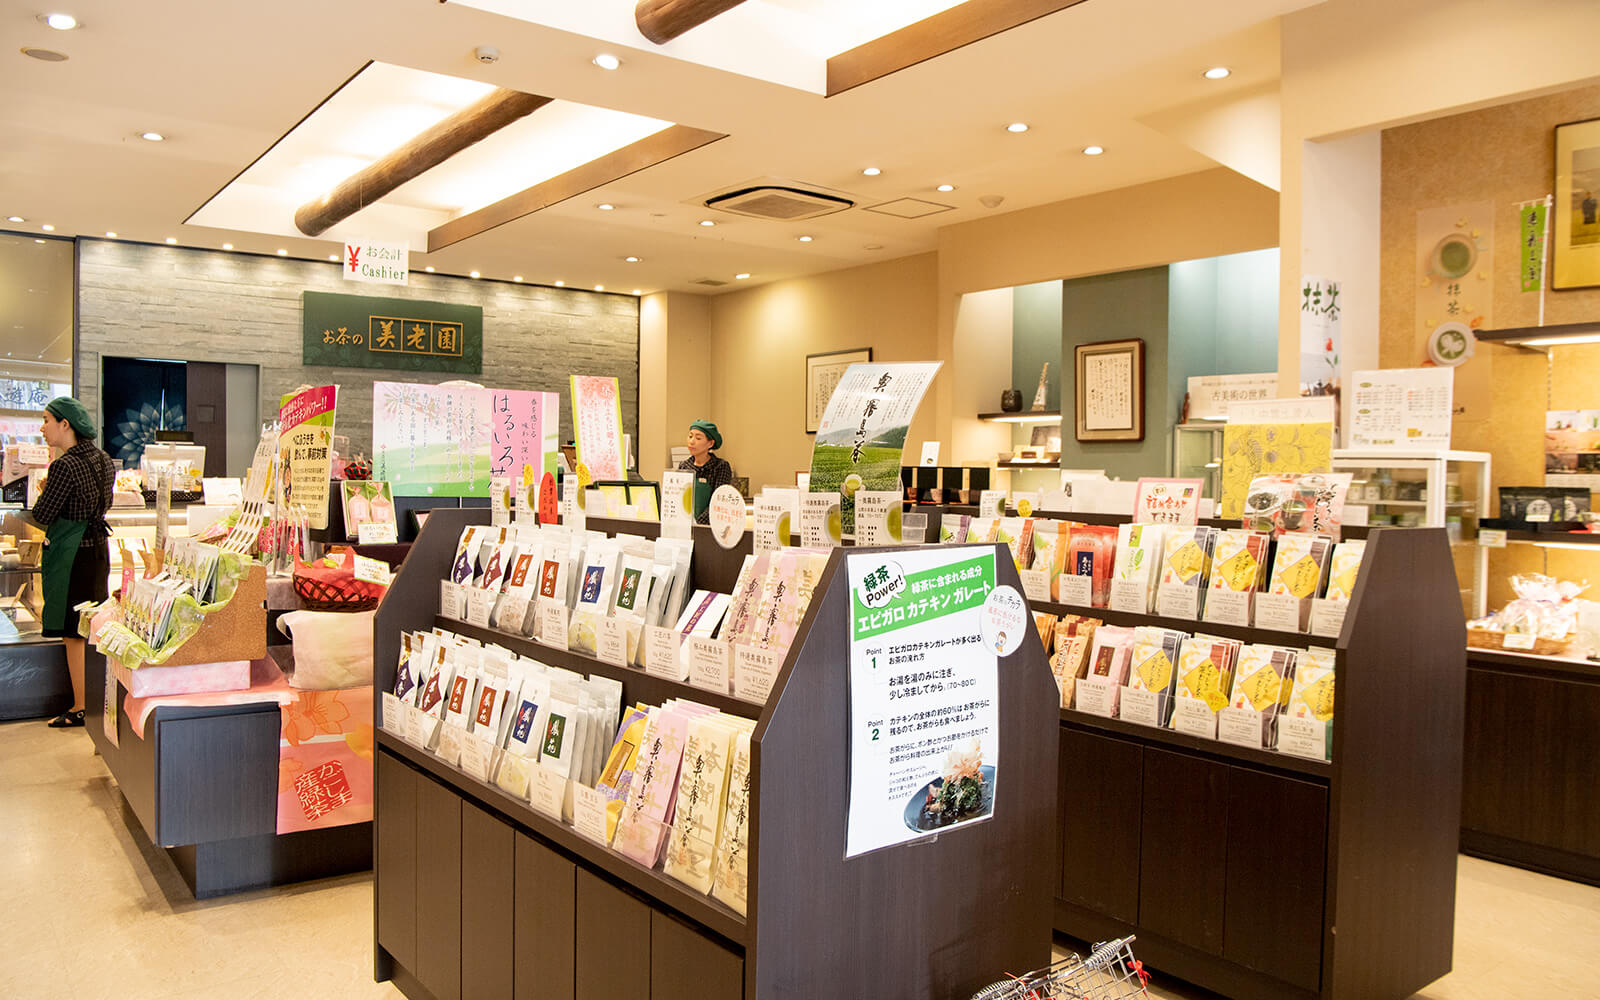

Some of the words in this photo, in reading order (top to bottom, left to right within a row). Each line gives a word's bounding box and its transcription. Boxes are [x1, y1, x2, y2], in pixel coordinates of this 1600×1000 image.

[366, 246, 402, 260] お会計
[362, 263, 405, 280] Cashier
[322, 327, 364, 345] お茶の
[376, 320, 457, 352] 美老園
[1212, 389, 1267, 401] 古美術の世界
[863, 565, 891, 592] 緑茶
[911, 565, 983, 594] 緑茶に含まれる成分
[866, 575, 904, 606] Power!
[858, 607, 905, 632] エビガロ
[907, 594, 951, 619] カテキン
[953, 580, 991, 604] ガレート
[866, 648, 882, 656] Point
[871, 657, 877, 669] 1
[867, 719, 884, 728] Point
[871, 728, 880, 741] 2
